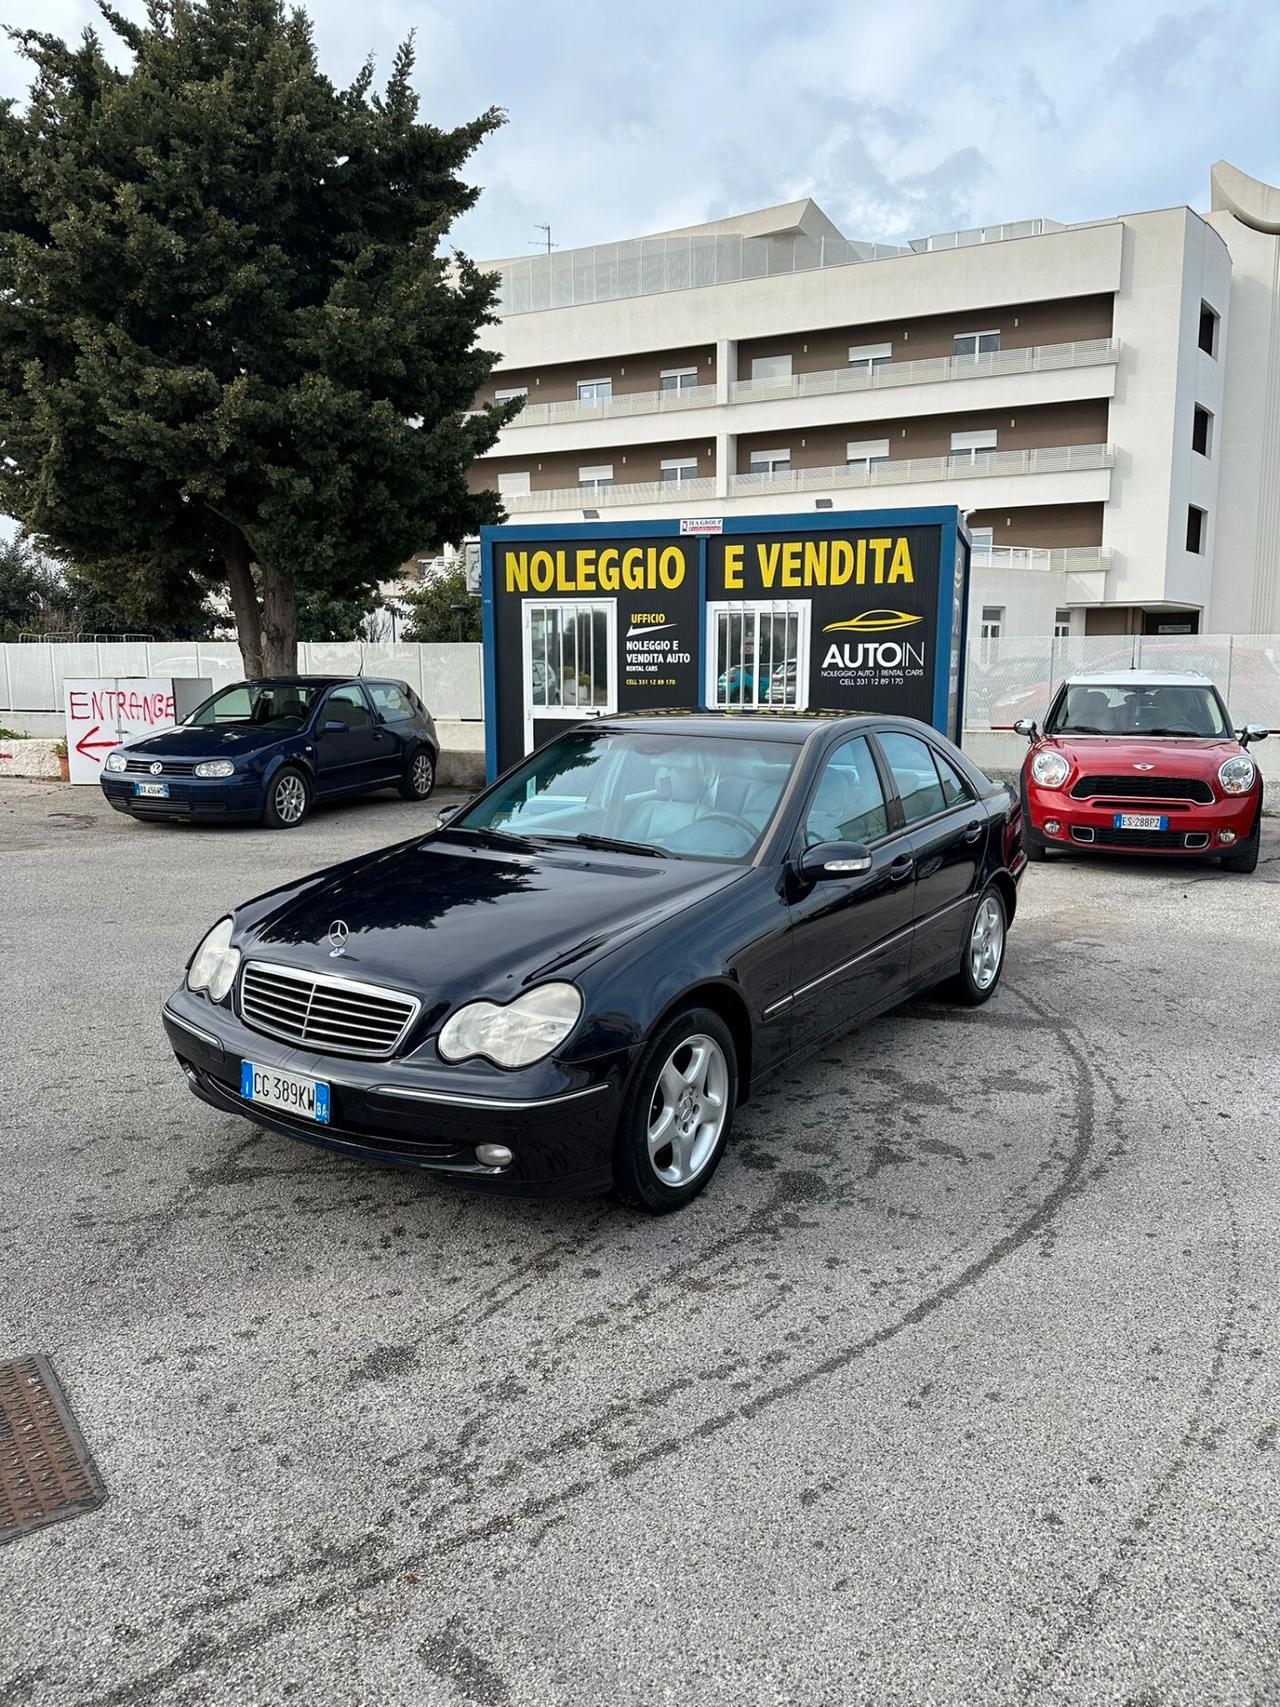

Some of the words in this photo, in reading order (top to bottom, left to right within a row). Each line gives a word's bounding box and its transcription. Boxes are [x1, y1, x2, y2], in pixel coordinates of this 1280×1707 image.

[505, 546, 686, 592] NOLEGGIO
[724, 544, 745, 589] E
[757, 537, 914, 588] VENDITA
[631, 613, 666, 624] UFFICIO
[626, 640, 671, 651] NOLEGGIO
[672, 640, 679, 651] E
[626, 653, 665, 664] VENDITA
[666, 653, 691, 664] AUTO
[821, 670, 857, 678] NOLEGGIO
[880, 669, 904, 677] RENTAL
[625, 678, 638, 686] CELL
[649, 678, 657, 686] 12
[665, 678, 677, 686] 170
[839, 678, 855, 686] CELL
[856, 678, 869, 686] 331
[891, 677, 904, 685] 170
